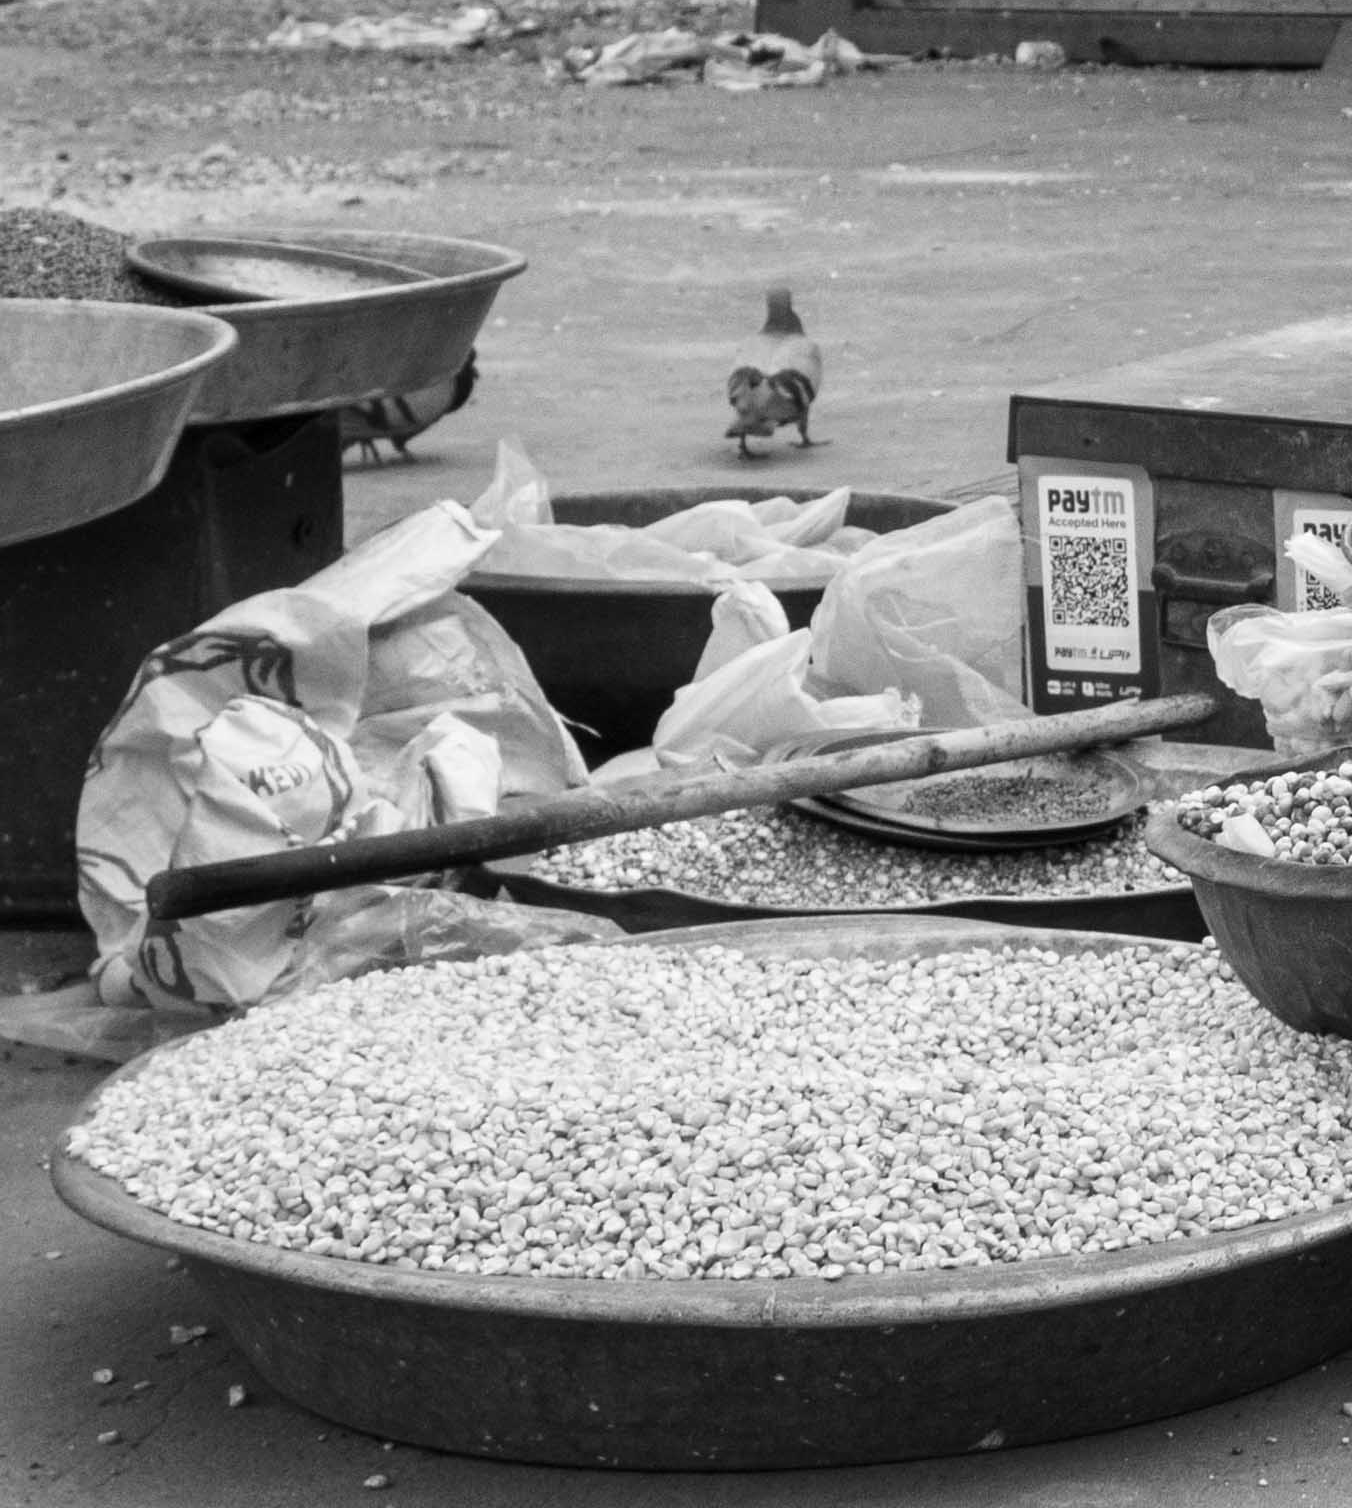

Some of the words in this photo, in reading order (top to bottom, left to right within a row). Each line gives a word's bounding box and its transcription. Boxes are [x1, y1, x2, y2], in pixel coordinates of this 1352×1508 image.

[1048, 516, 1099, 529] Accepted
[1101, 518, 1127, 528] Here
[1303, 522, 1348, 547] pay
